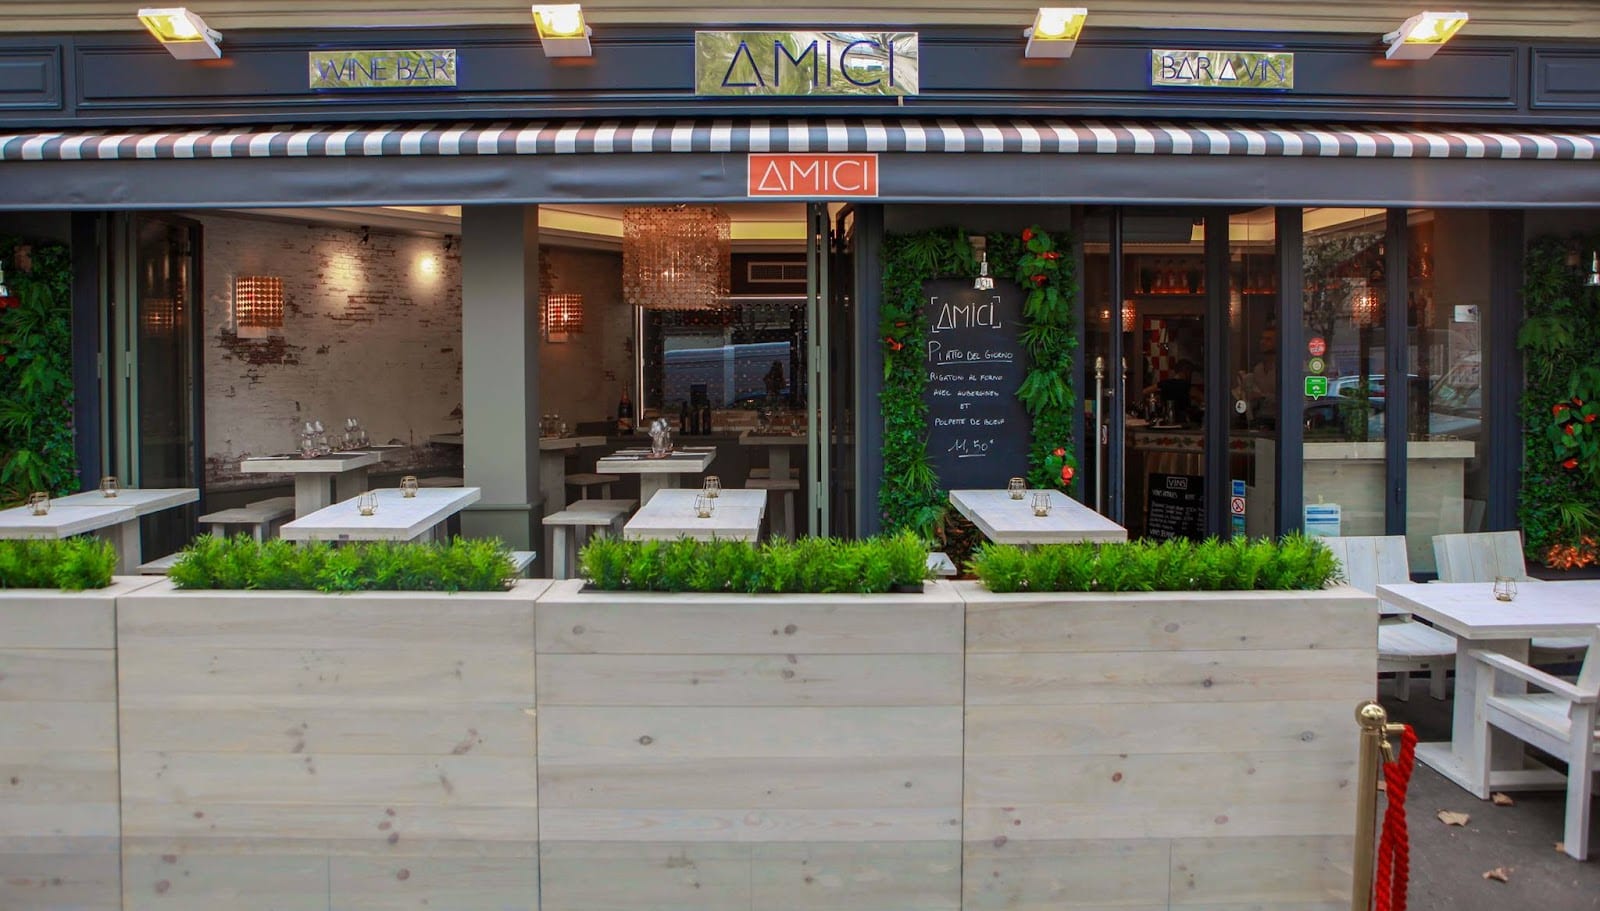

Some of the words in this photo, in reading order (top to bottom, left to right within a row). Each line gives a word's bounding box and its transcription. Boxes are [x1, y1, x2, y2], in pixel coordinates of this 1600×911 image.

[316, 56, 388, 81] WINE
[397, 55, 450, 80] BAR
[721, 40, 894, 87] AMICI
[1162, 55, 1213, 80] BAR
[1242, 58, 1285, 82] VIN
[757, 160, 868, 191] AMICI
[937, 302, 994, 329] AMICI
[966, 351, 981, 361] DEL
[960, 402, 971, 410] ET
[1168, 479, 1186, 488] VINS
